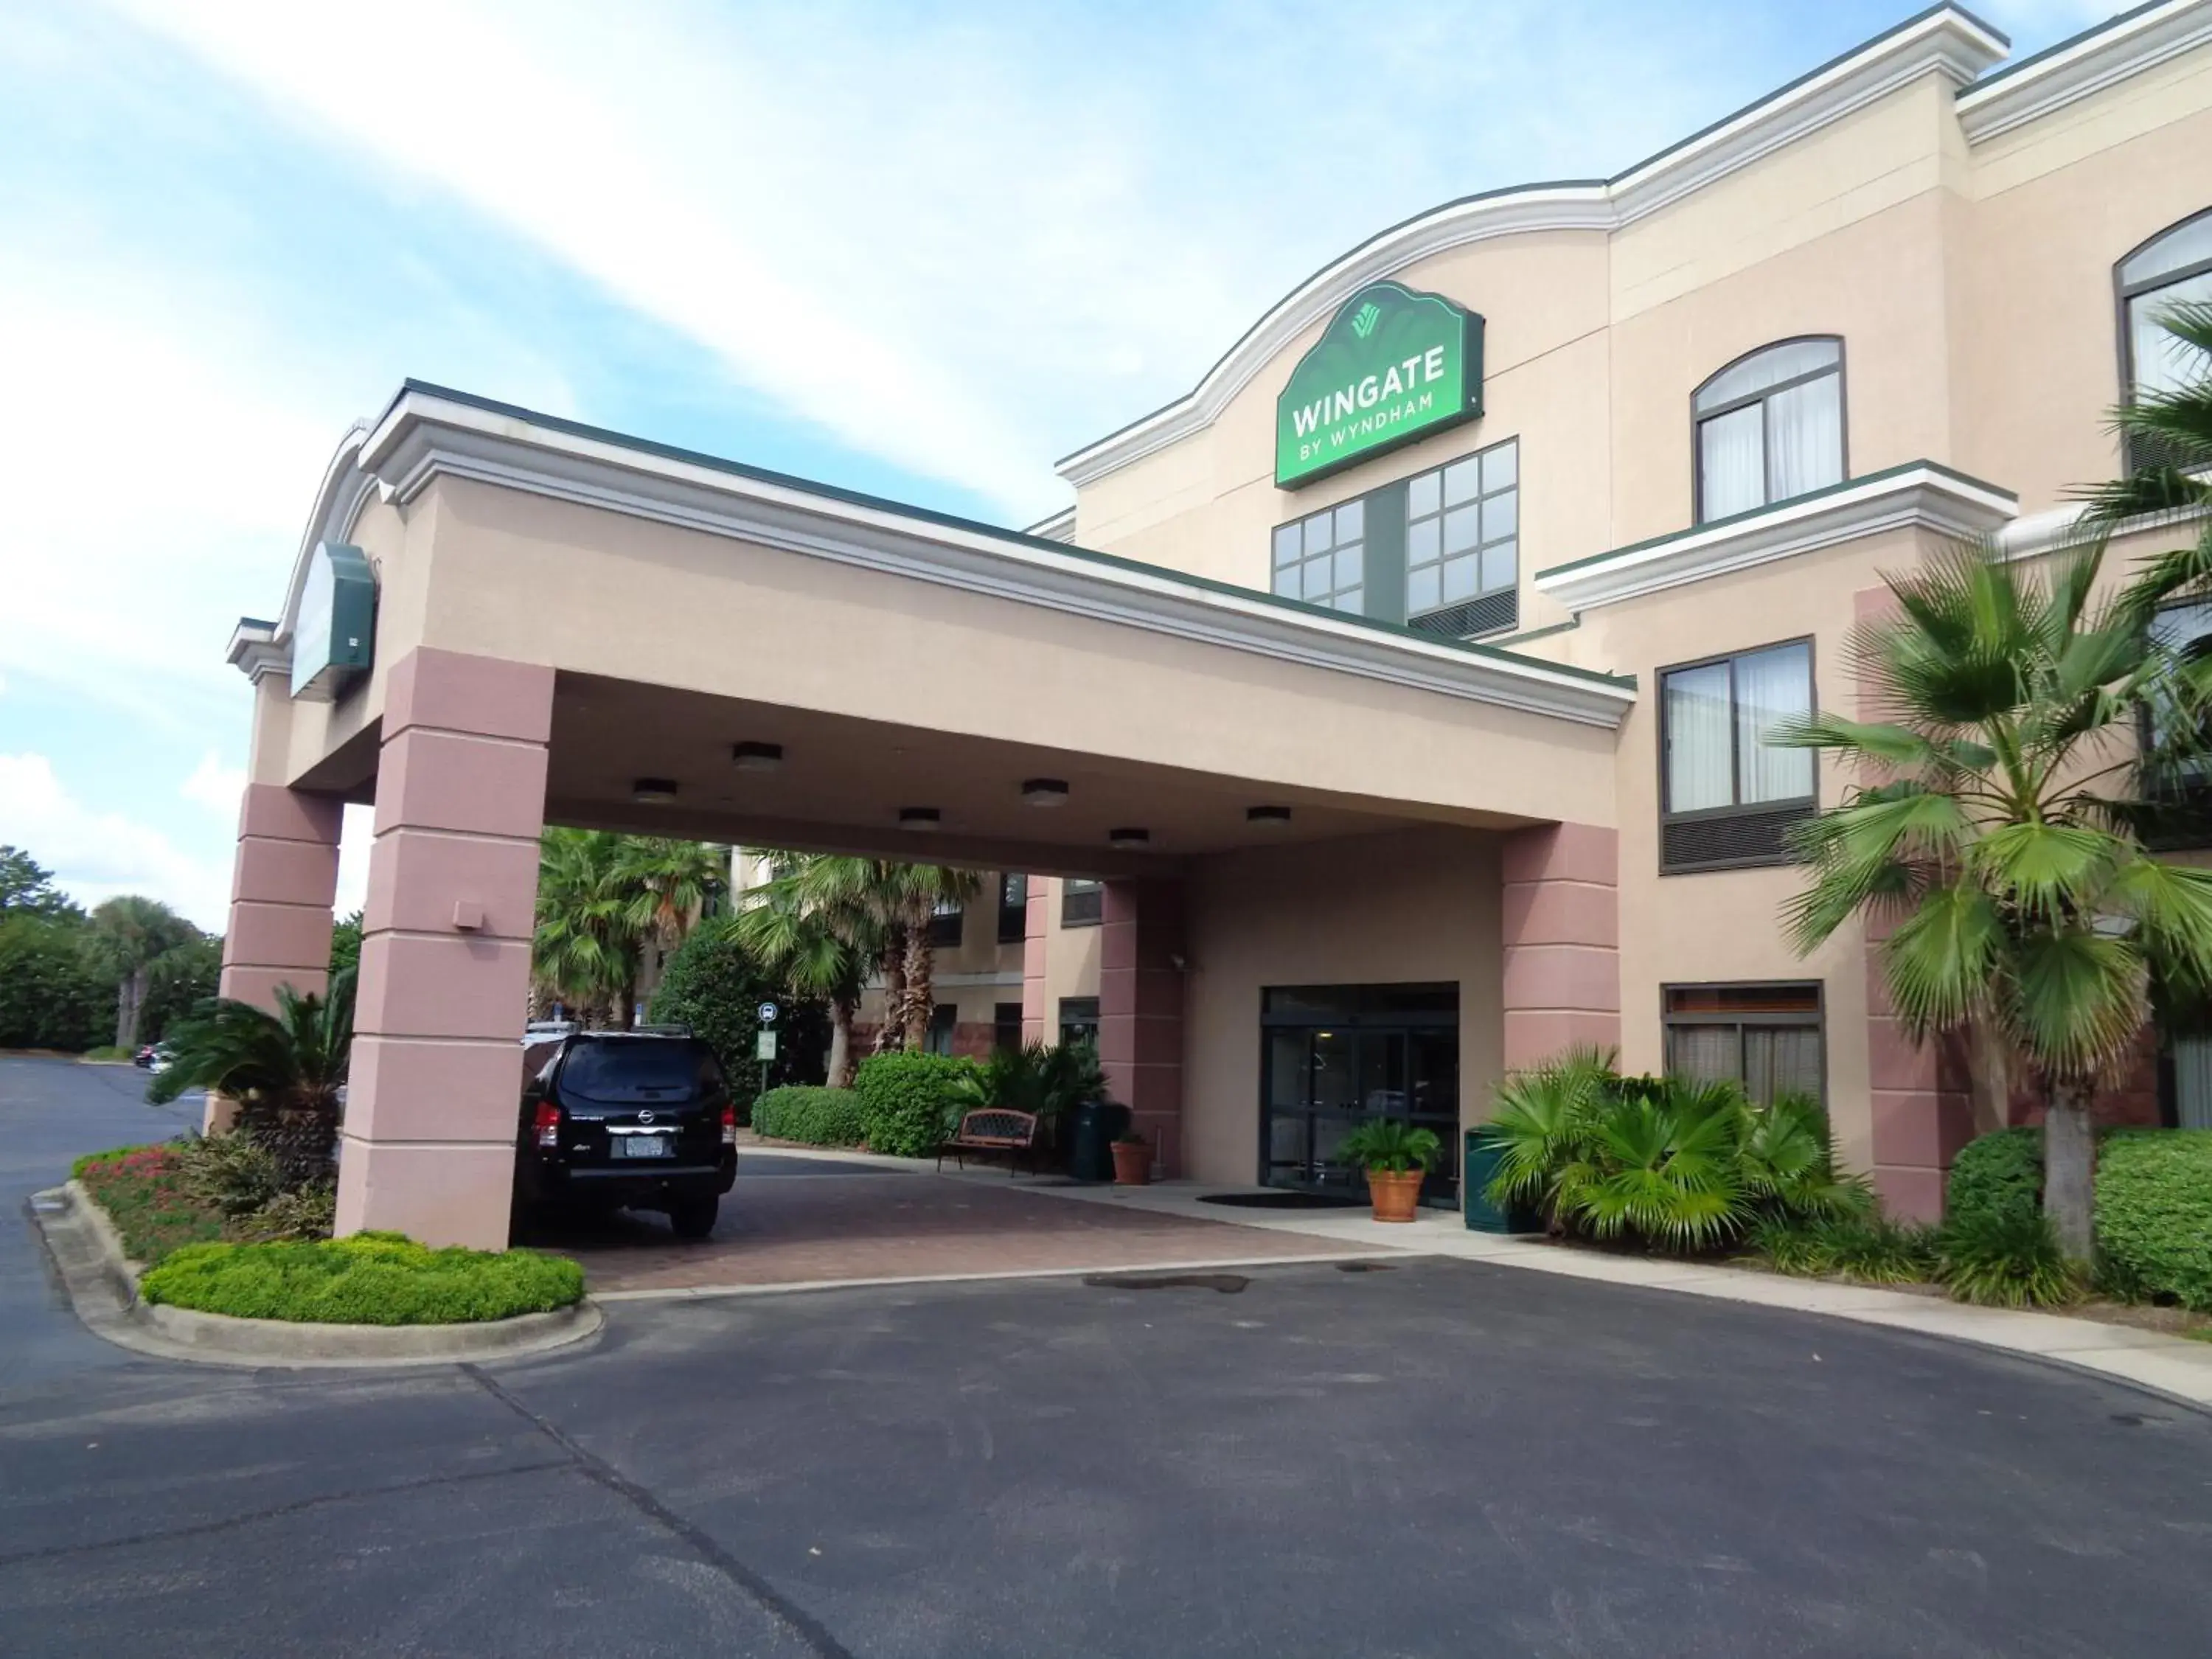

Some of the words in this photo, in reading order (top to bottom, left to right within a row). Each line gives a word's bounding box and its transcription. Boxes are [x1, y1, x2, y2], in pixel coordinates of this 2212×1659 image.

[1293, 345, 1445, 438] WINGATE
[1300, 439, 1321, 461] BY
[1330, 392, 1433, 448] WYNDHAM
